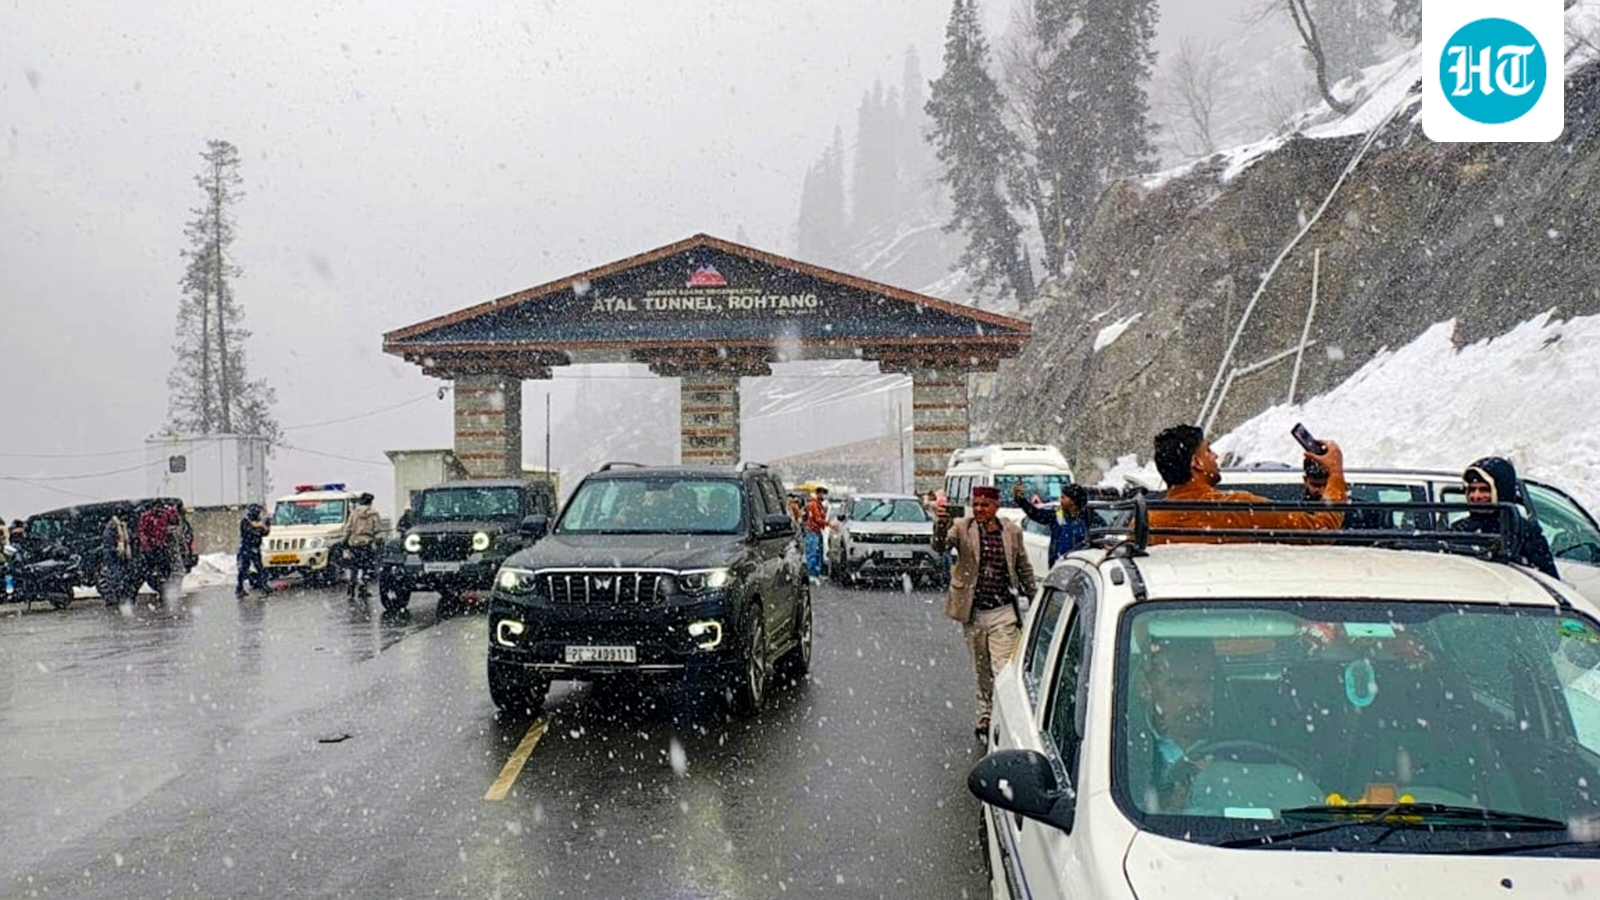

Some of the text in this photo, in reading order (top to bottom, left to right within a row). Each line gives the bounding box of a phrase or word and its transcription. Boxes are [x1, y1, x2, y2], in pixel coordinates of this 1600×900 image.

[592, 294, 818, 313] ATAL TUNNEL, ROHTANG
